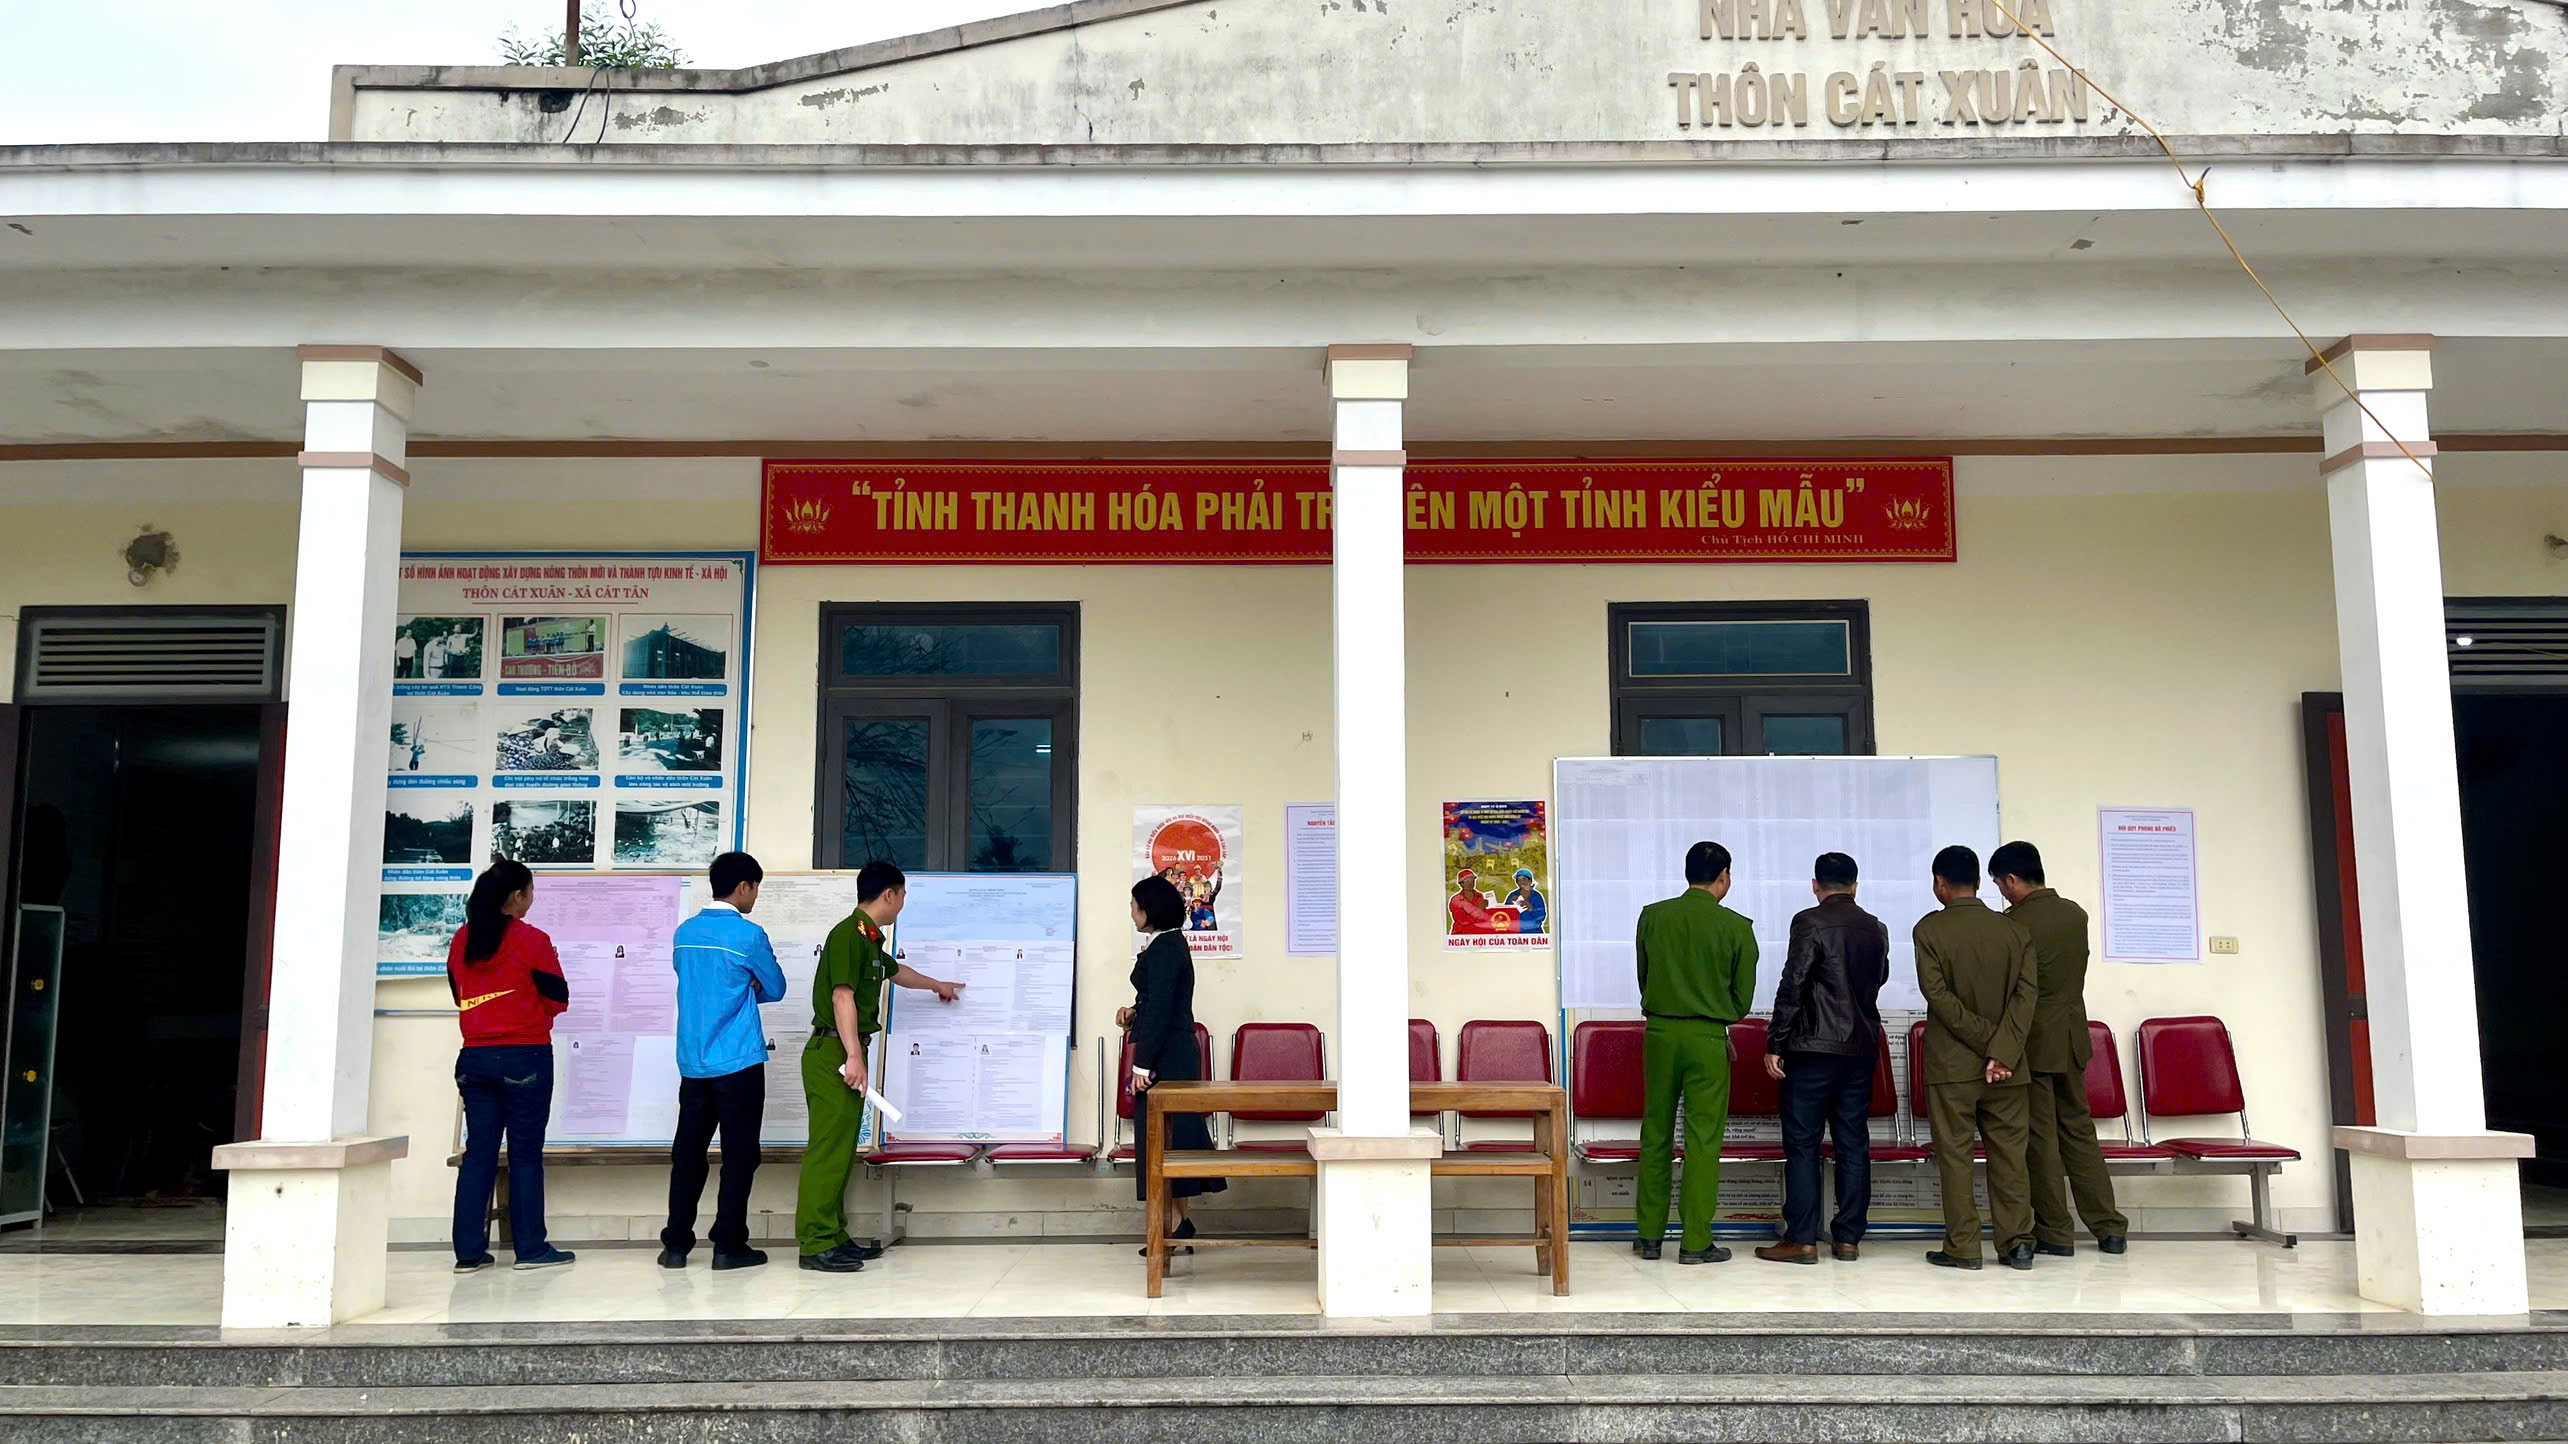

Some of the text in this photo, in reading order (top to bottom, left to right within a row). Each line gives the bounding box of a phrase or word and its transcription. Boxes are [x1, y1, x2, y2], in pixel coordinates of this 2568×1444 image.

[1668, 58, 2088, 128] THÔN CÁT XUÂN
[971, 491, 1095, 531] THANH
[1108, 483, 1183, 531] HÓA
[1197, 478, 1283, 531] PHẢI
[1406, 482, 1455, 530] ÊN
[1469, 482, 1548, 538] MỘT
[1560, 477, 1647, 529] TỈNH
[1660, 473, 1746, 529] KIỂU
[1701, 534, 1729, 545] Chủ
[1734, 534, 1763, 547] Tịch
[1792, 532, 1820, 544] CHÍ
[1823, 534, 1864, 544] MINH
[457, 567, 477, 582] HOẠT
[479, 564, 501, 582] ĐỘNG
[503, 565, 518, 579] XÂY
[543, 564, 566, 579] NÔNG
[568, 564, 588, 579] THÔN
[608, 564, 617, 579] VÀ
[620, 564, 645, 579] THÀNH
[664, 567, 683, 580] KINH
[685, 564, 694, 580] TẾ
[701, 565, 712, 580] XÃ
[714, 566, 728, 582] HỘI
[462, 585, 499, 599] THÔN
[502, 584, 527, 599] CÁT
[529, 584, 566, 599] XUÂN
[575, 585, 592, 599] XÃ
[595, 585, 622, 598] CÁT
[623, 585, 649, 598] TÂN
[1177, 850, 1195, 861] XVI
[1448, 935, 1548, 947] NGÀY HỘI CỦA TOÀN DÂN
[1583, 1179, 1592, 1187] 14
